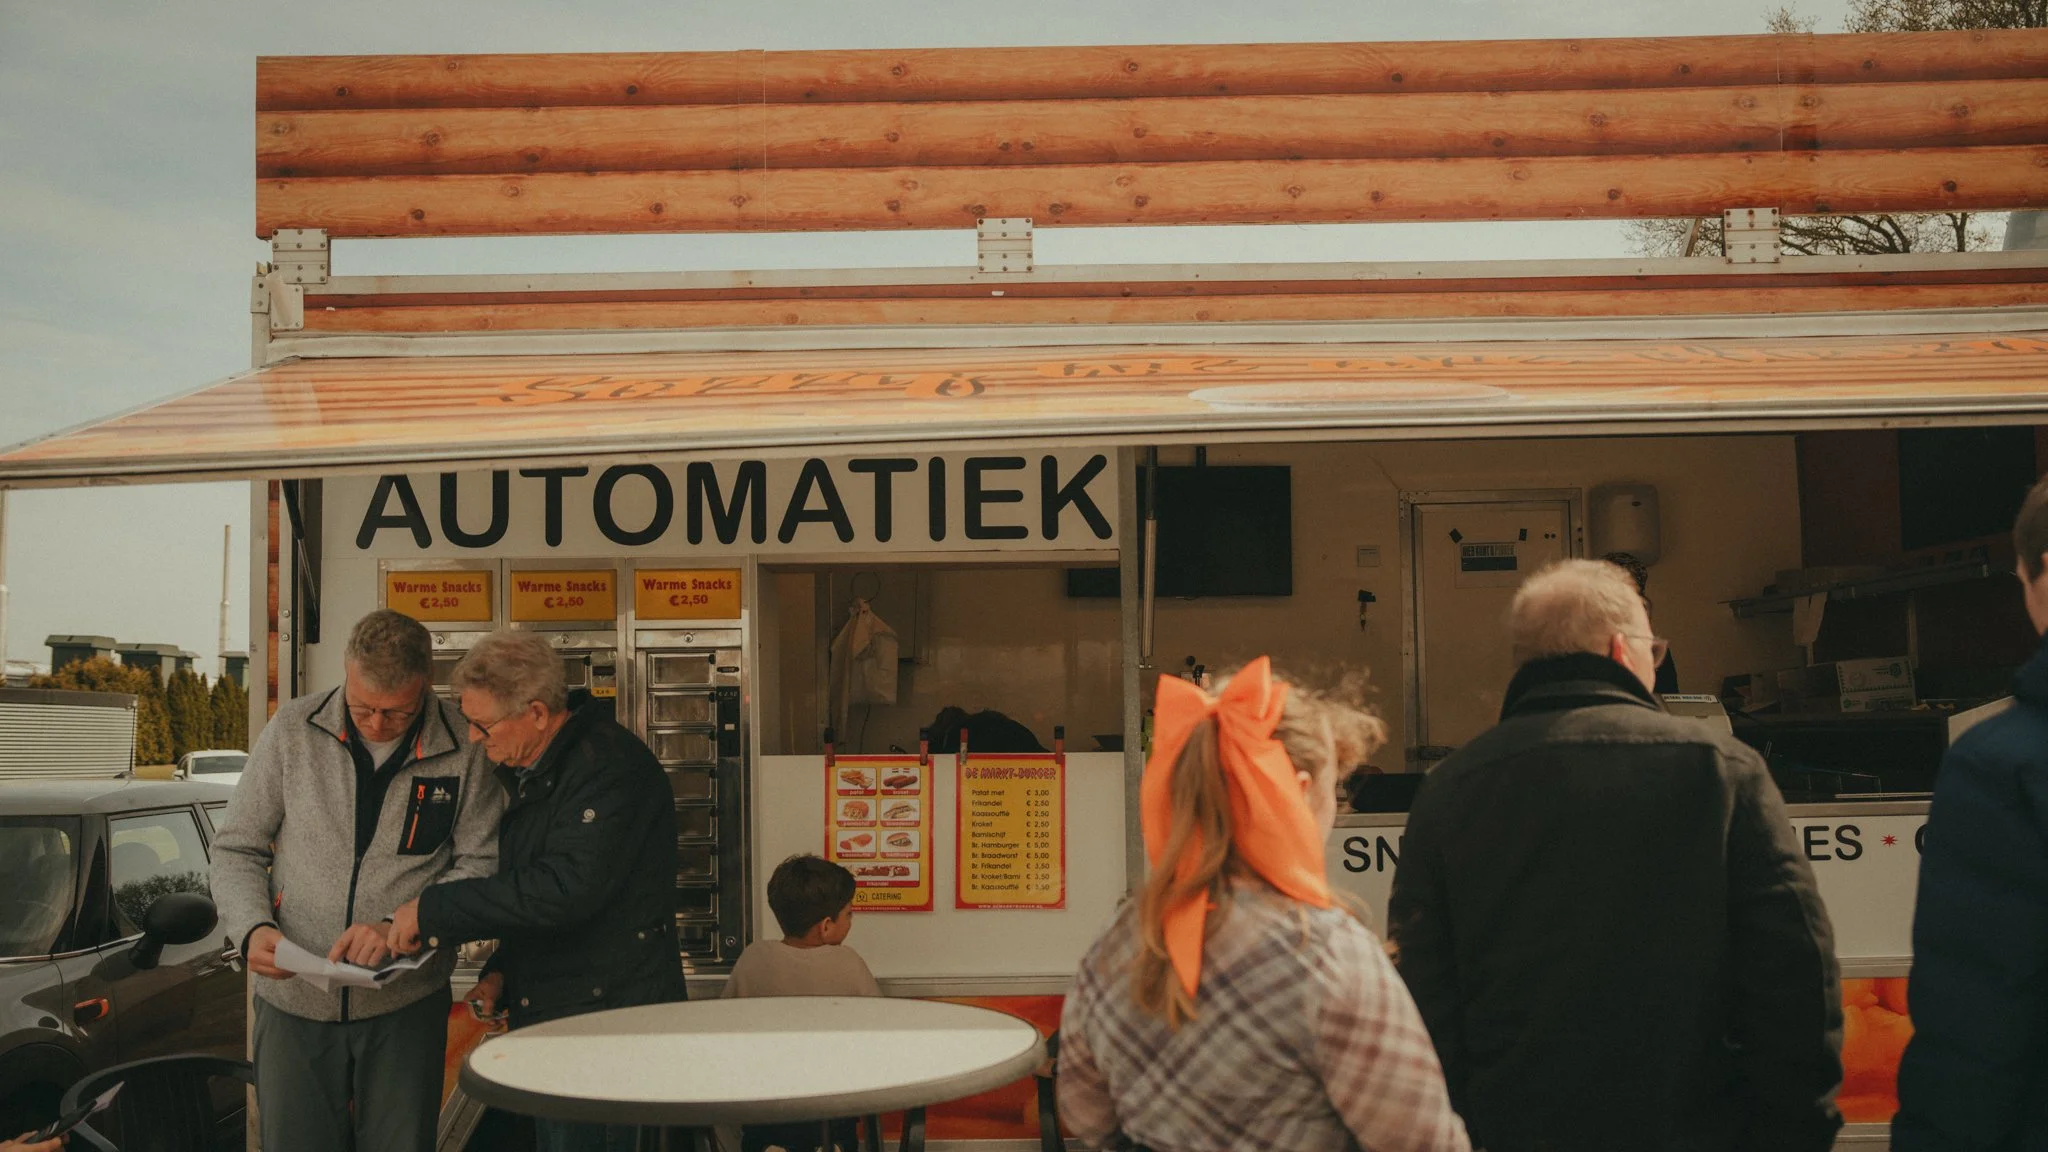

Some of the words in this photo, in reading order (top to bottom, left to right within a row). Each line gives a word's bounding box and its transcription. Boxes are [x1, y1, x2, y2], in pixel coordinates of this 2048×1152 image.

[356, 454, 1113, 549] AUTOMATIEK
[393, 581, 437, 594] Warme
[441, 581, 482, 593] Snacks
[518, 580, 562, 593] Warme
[566, 580, 607, 592] Snacks
[643, 578, 687, 591] Warme
[691, 578, 732, 590] Snacks
[972, 789, 989, 797] Patat
[990, 789, 1005, 797] met
[981, 842, 1020, 850] Hamburger
[1792, 824, 1864, 862] ES
[1343, 835, 1404, 873] SN
[871, 892, 902, 901] CATERING
